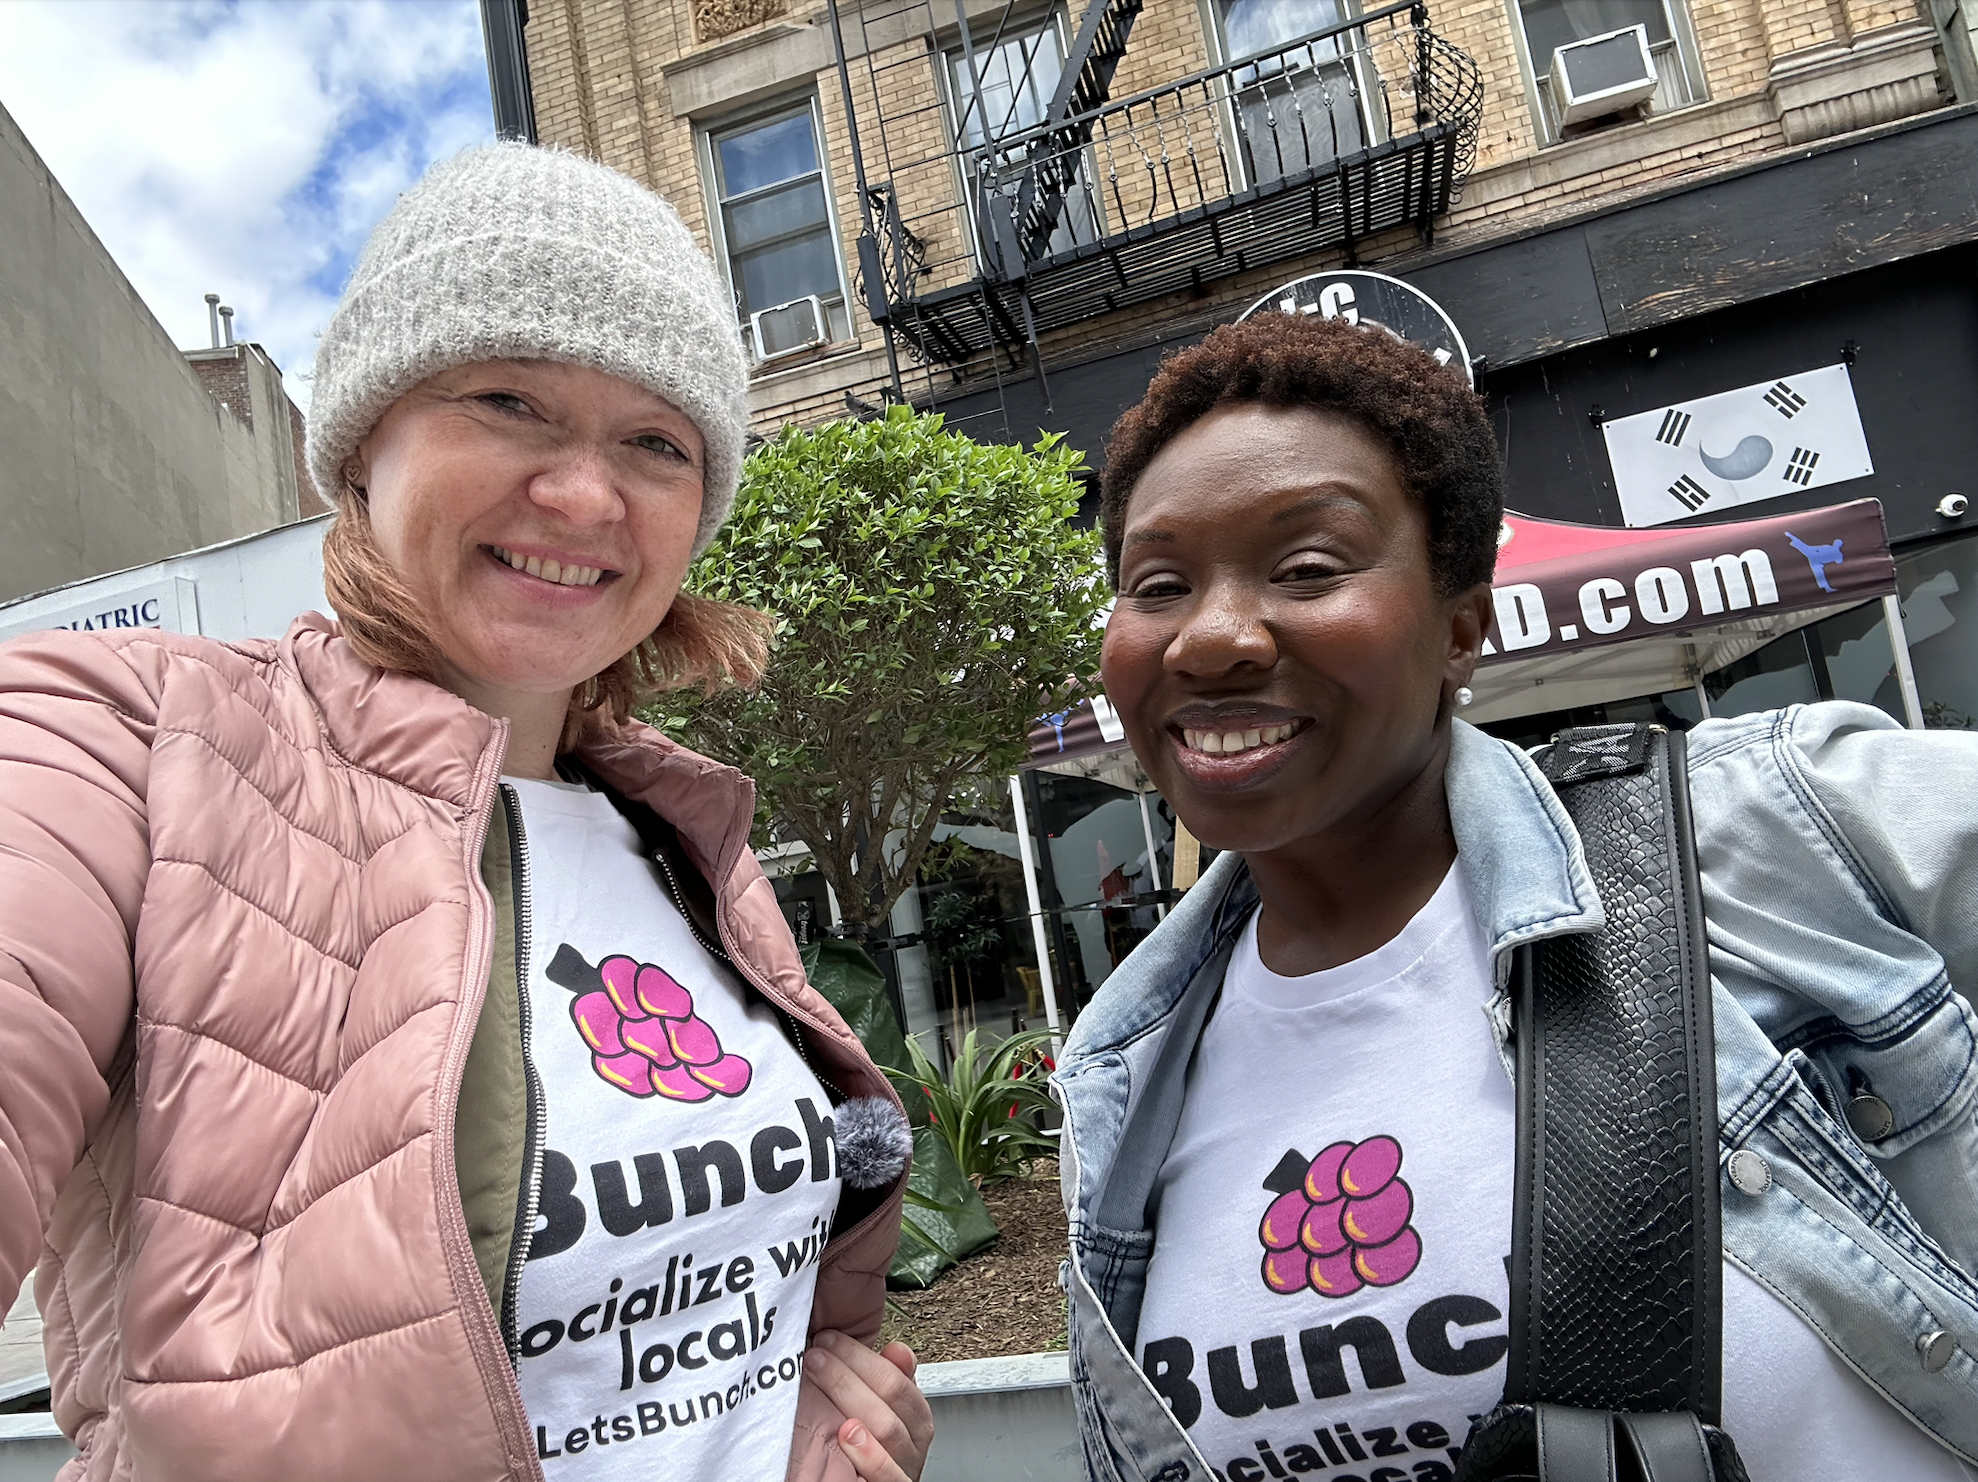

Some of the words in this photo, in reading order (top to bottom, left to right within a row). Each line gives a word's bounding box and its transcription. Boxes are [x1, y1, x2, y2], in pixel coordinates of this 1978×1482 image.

[54, 598, 160, 631] ATRIC
[1481, 547, 1779, 657] D.com
[526, 1097, 842, 1262] Bunch
[520, 1253, 755, 1358] ocialize
[767, 1209, 835, 1279] wit
[618, 1291, 778, 1391] locals
[1142, 1254, 1510, 1430] Bunc
[1211, 1420, 1451, 1482] cialize
